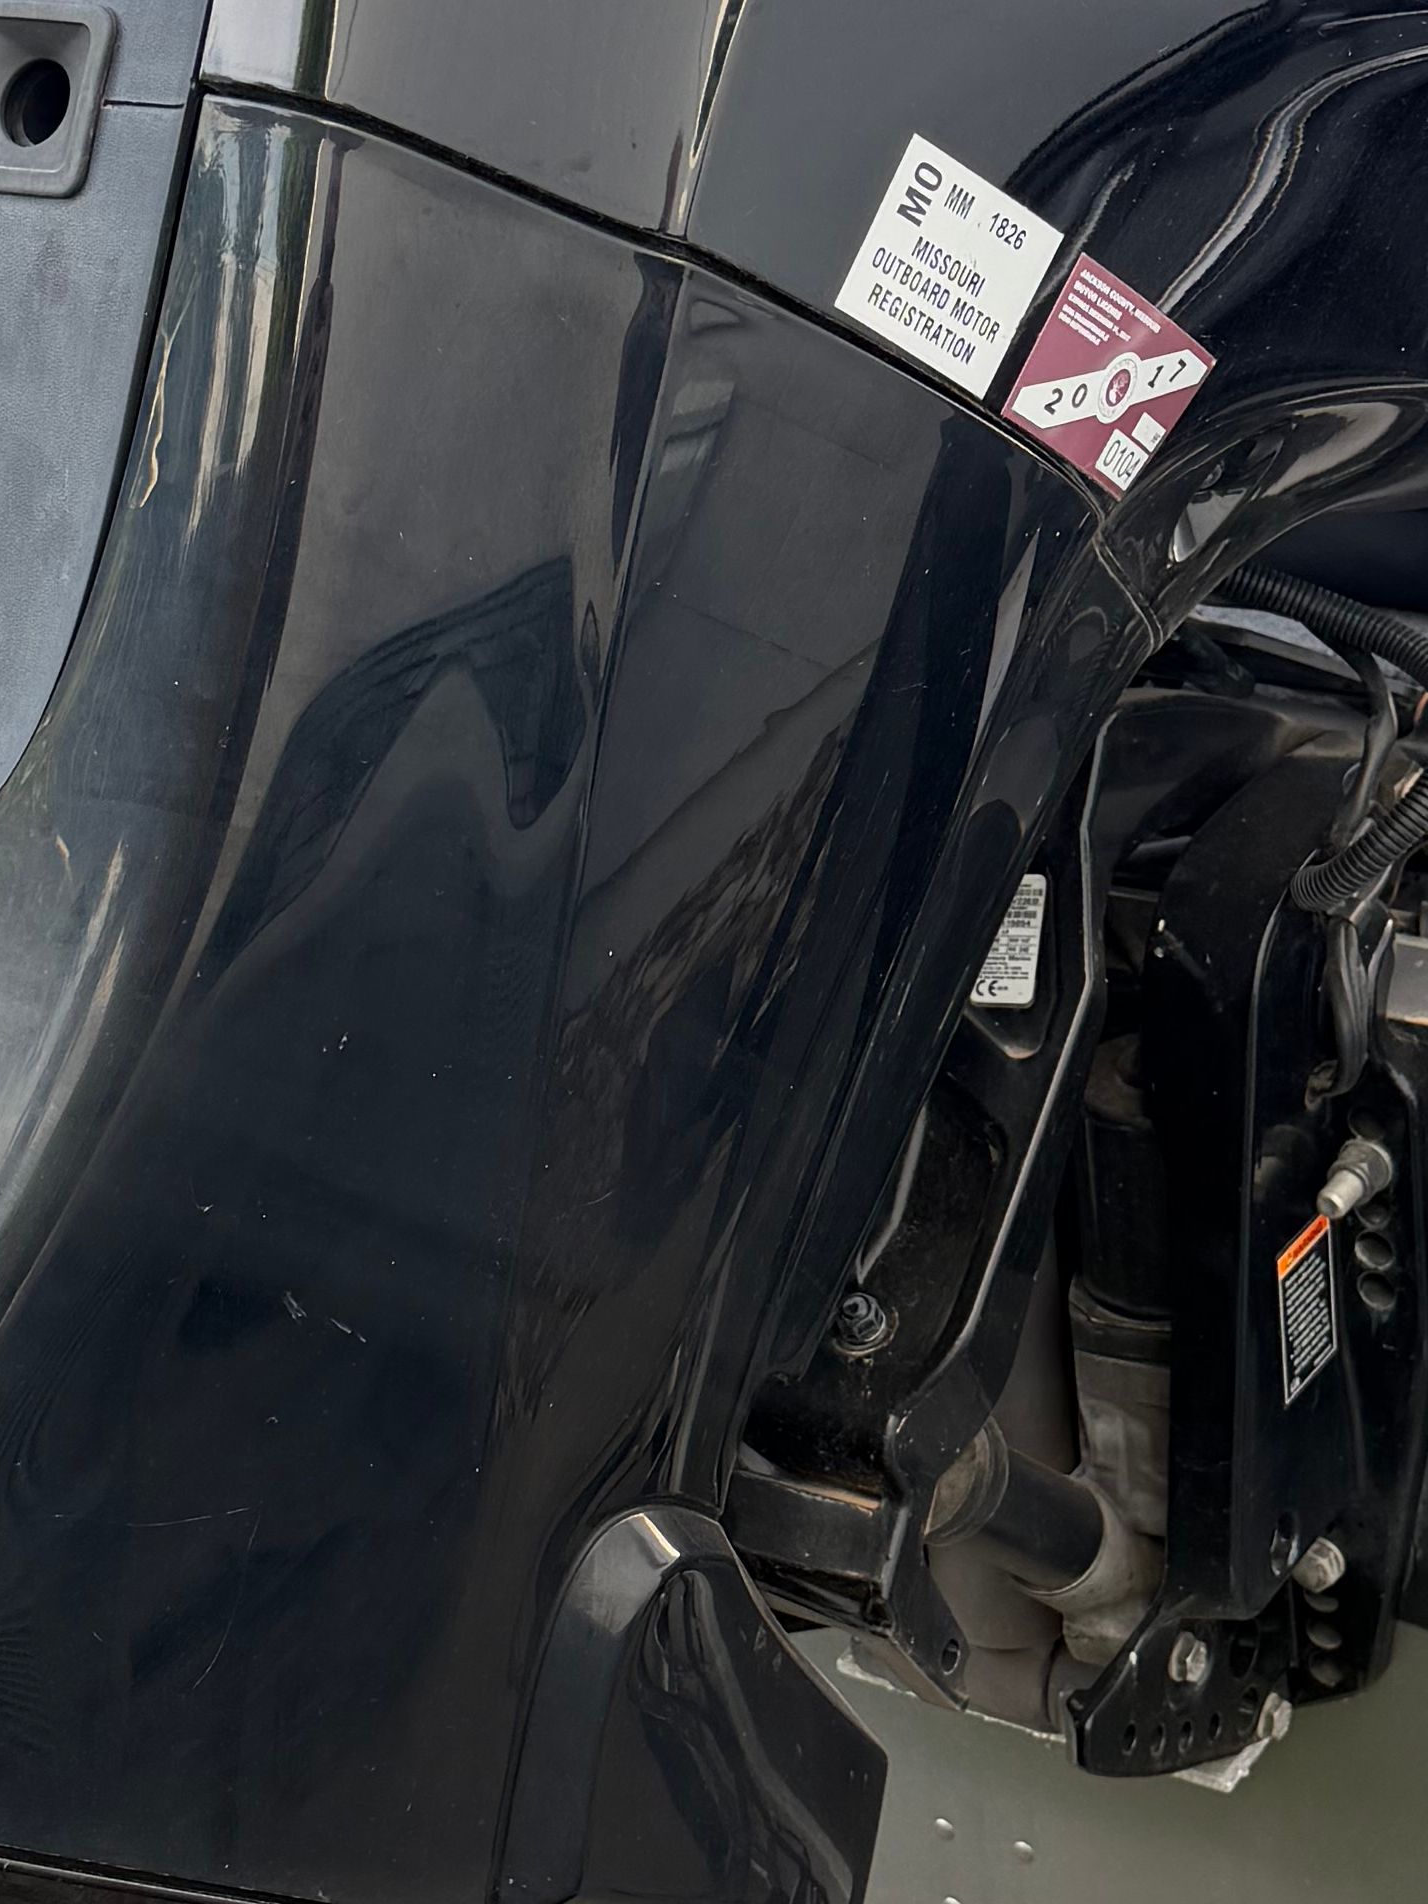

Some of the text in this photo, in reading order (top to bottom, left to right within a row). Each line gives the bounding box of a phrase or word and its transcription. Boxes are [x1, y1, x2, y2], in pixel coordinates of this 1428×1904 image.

[895, 160, 944, 228] MO
[943, 182, 1028, 251] MM 1826
[871, 246, 949, 311] OUTBOARD
[949, 296, 1001, 345] MOTOR
[911, 234, 987, 299] MISSOURI
[866, 281, 977, 366] REGISTRATION
